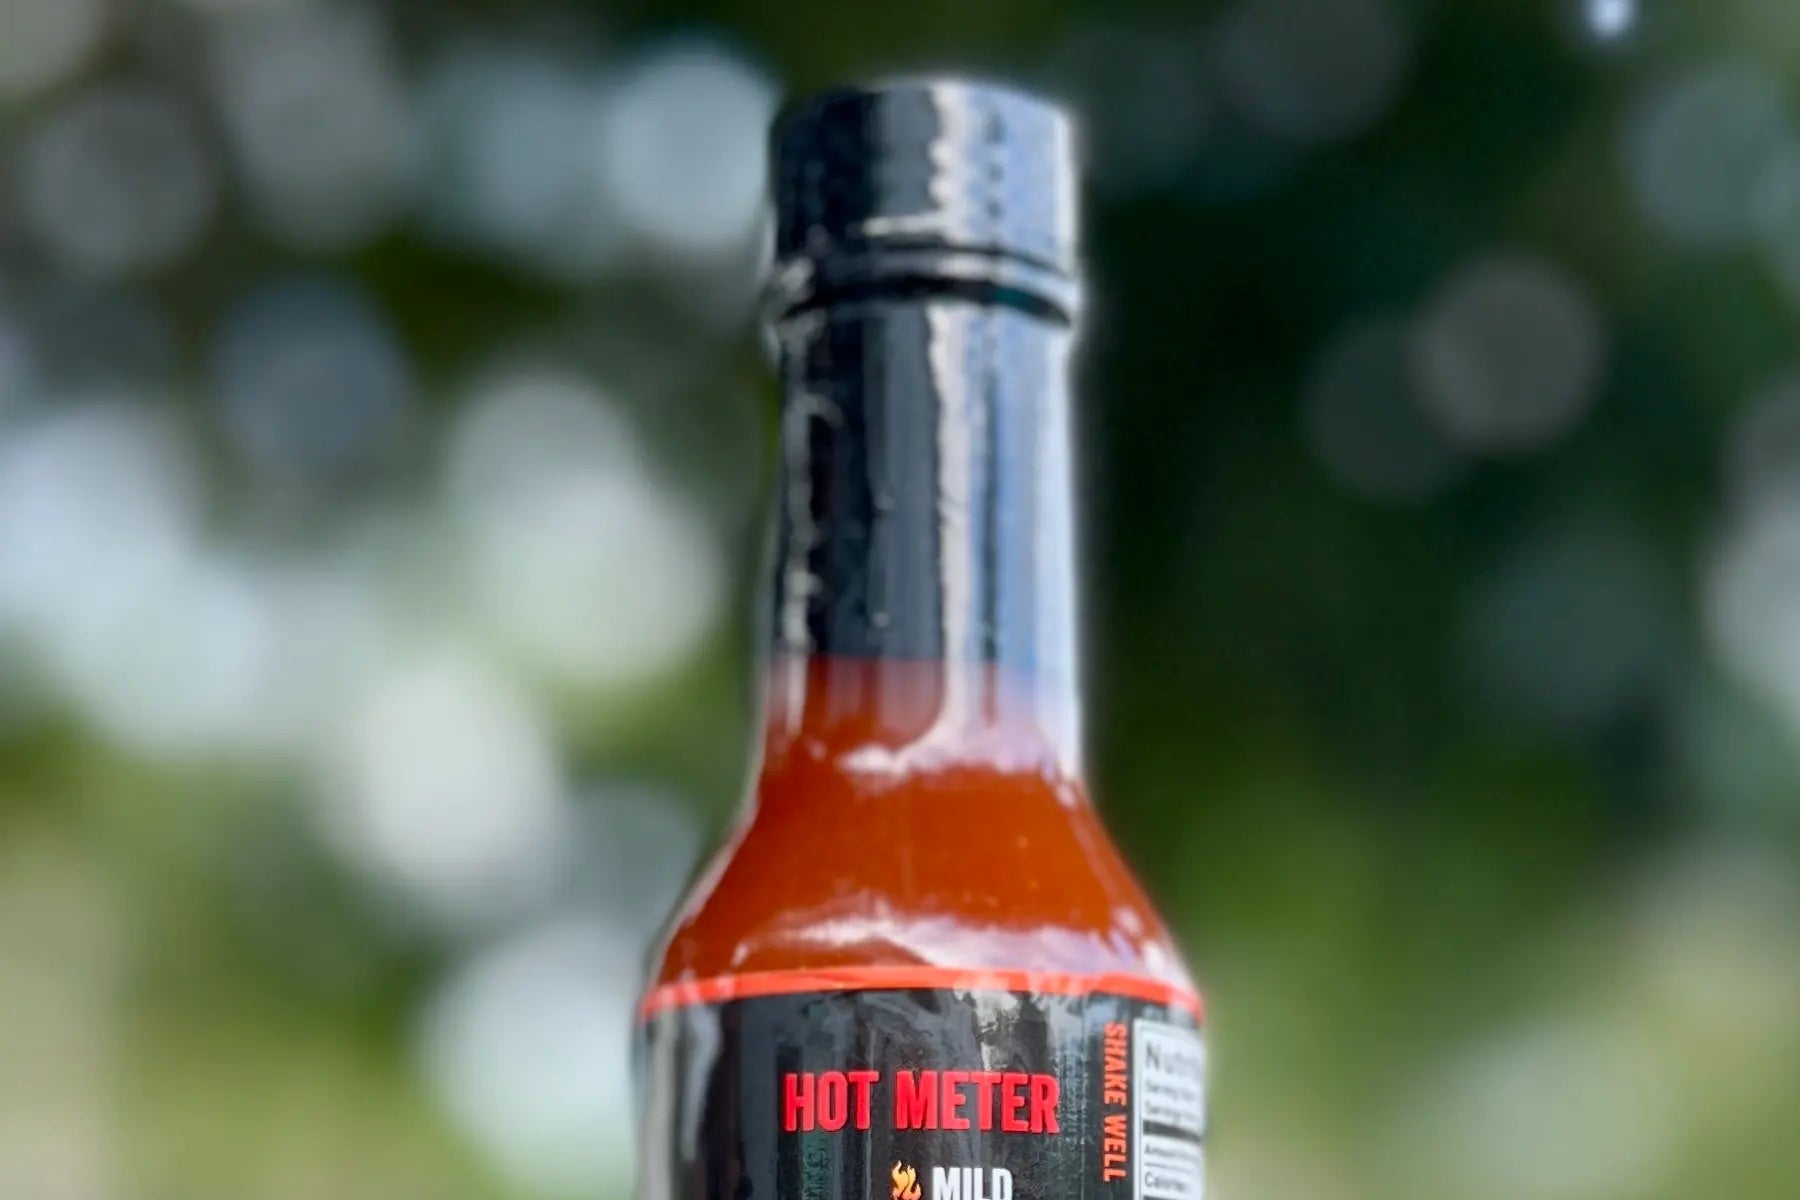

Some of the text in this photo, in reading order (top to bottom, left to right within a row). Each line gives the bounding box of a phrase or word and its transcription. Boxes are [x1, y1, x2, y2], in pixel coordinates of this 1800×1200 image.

[784, 1071, 1061, 1134] HOT METER
[1103, 1022, 1127, 1182] SHAKE WELL
